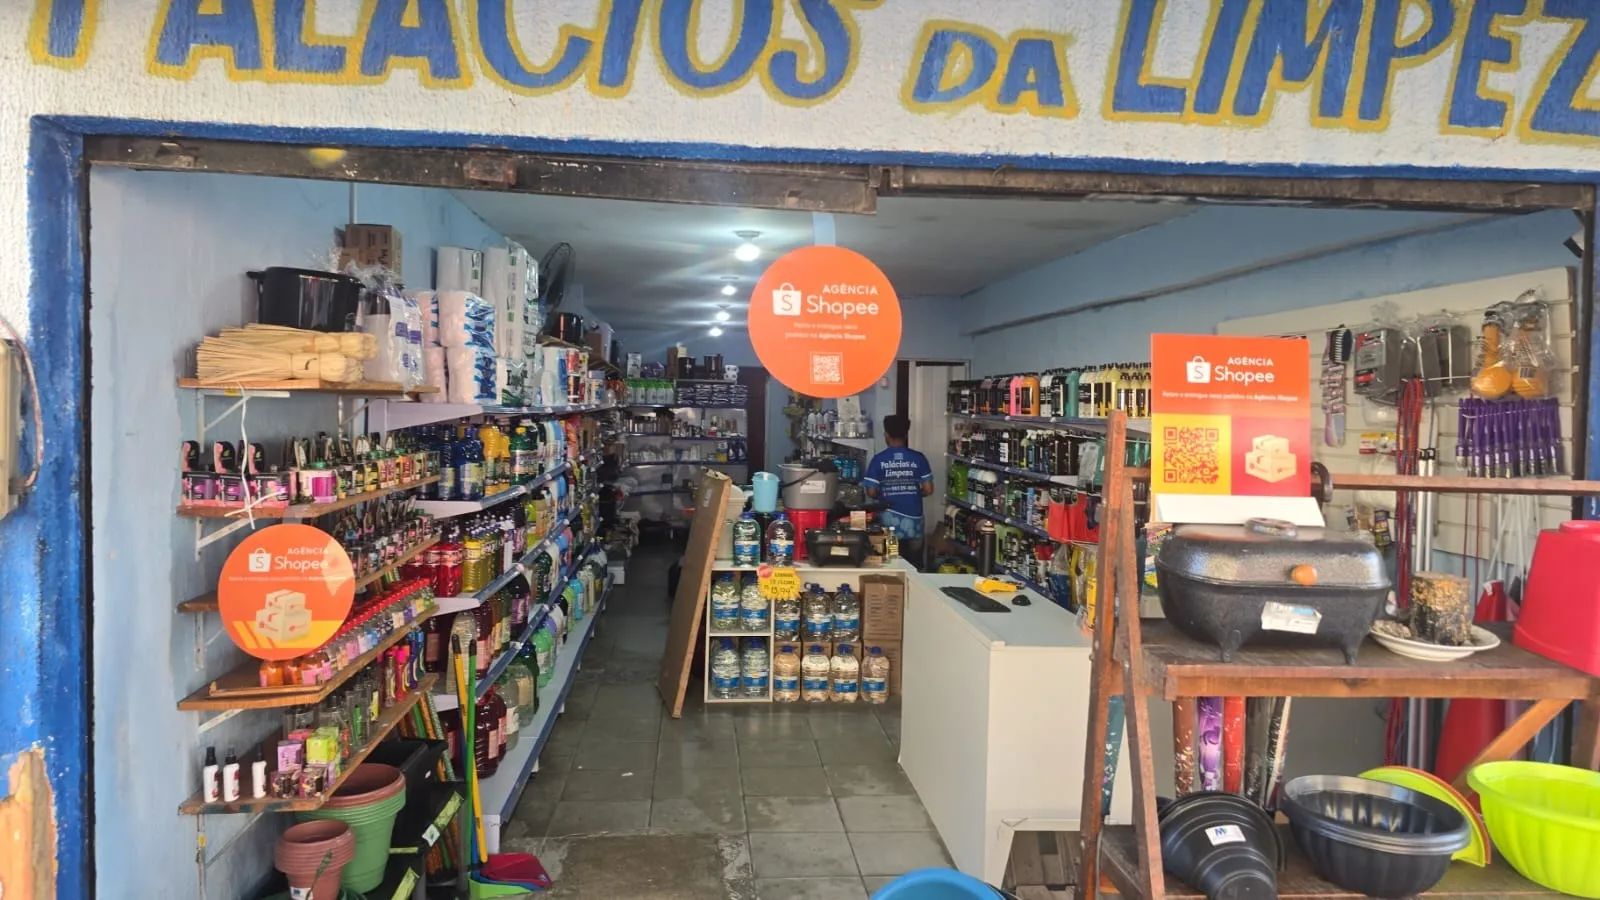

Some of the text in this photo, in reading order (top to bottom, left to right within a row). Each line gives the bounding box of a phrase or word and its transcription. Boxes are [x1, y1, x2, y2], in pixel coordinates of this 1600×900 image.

[902, 20, 1078, 119] DA
[822, 283, 879, 296] AGÊNCIA
[806, 294, 880, 320] Shopee
[1227, 356, 1274, 367] AGÊNCIA
[1214, 365, 1275, 386] Shopee
[287, 547, 329, 556] AGÊNCIA
[274, 556, 329, 573] Shopee
